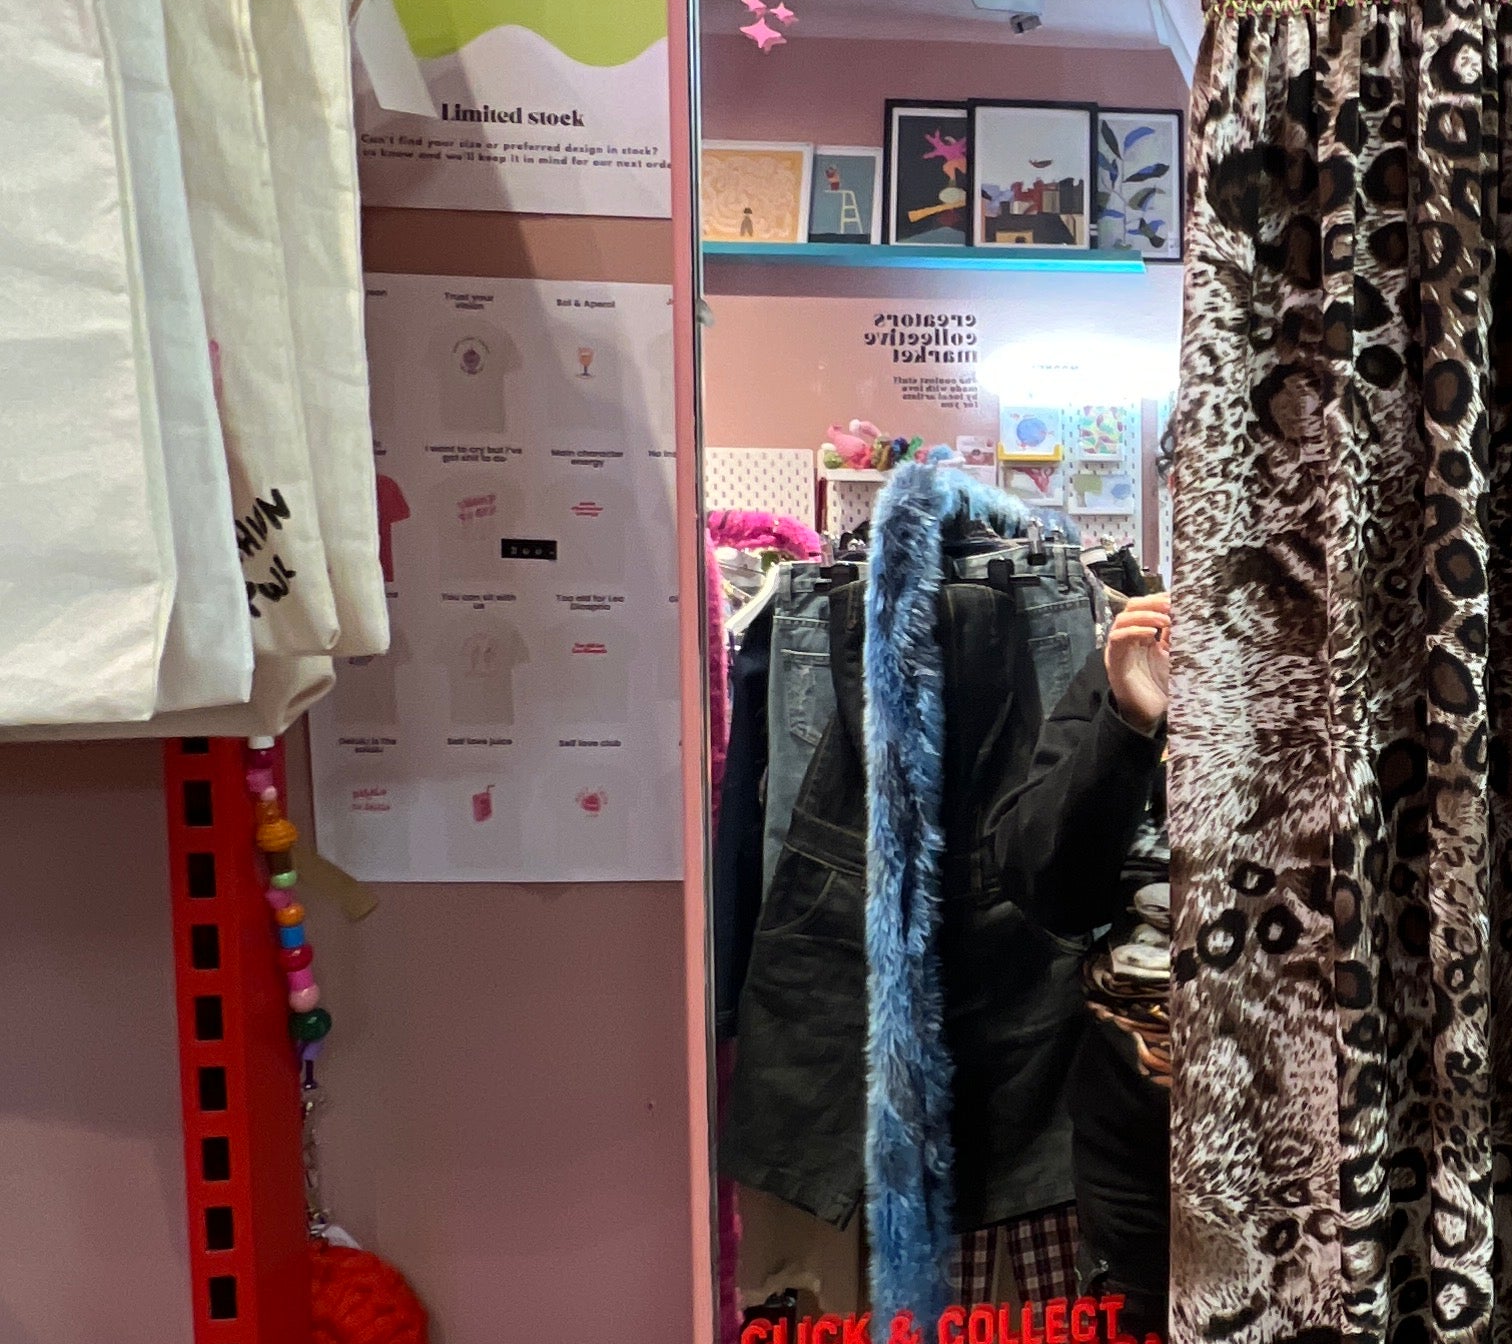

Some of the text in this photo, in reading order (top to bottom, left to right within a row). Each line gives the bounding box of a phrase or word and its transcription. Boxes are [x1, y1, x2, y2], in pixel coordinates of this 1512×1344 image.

[441, 103, 585, 127] Limited stock
[504, 141, 560, 152] preferred
[565, 144, 603, 155] design
[607, 145, 618, 154] in
[622, 146, 658, 155] stock?
[523, 155, 534, 164] in
[539, 155, 567, 164] mind
[572, 156, 588, 165] for
[617, 159, 642, 168] next
[646, 159, 671, 169] orde
